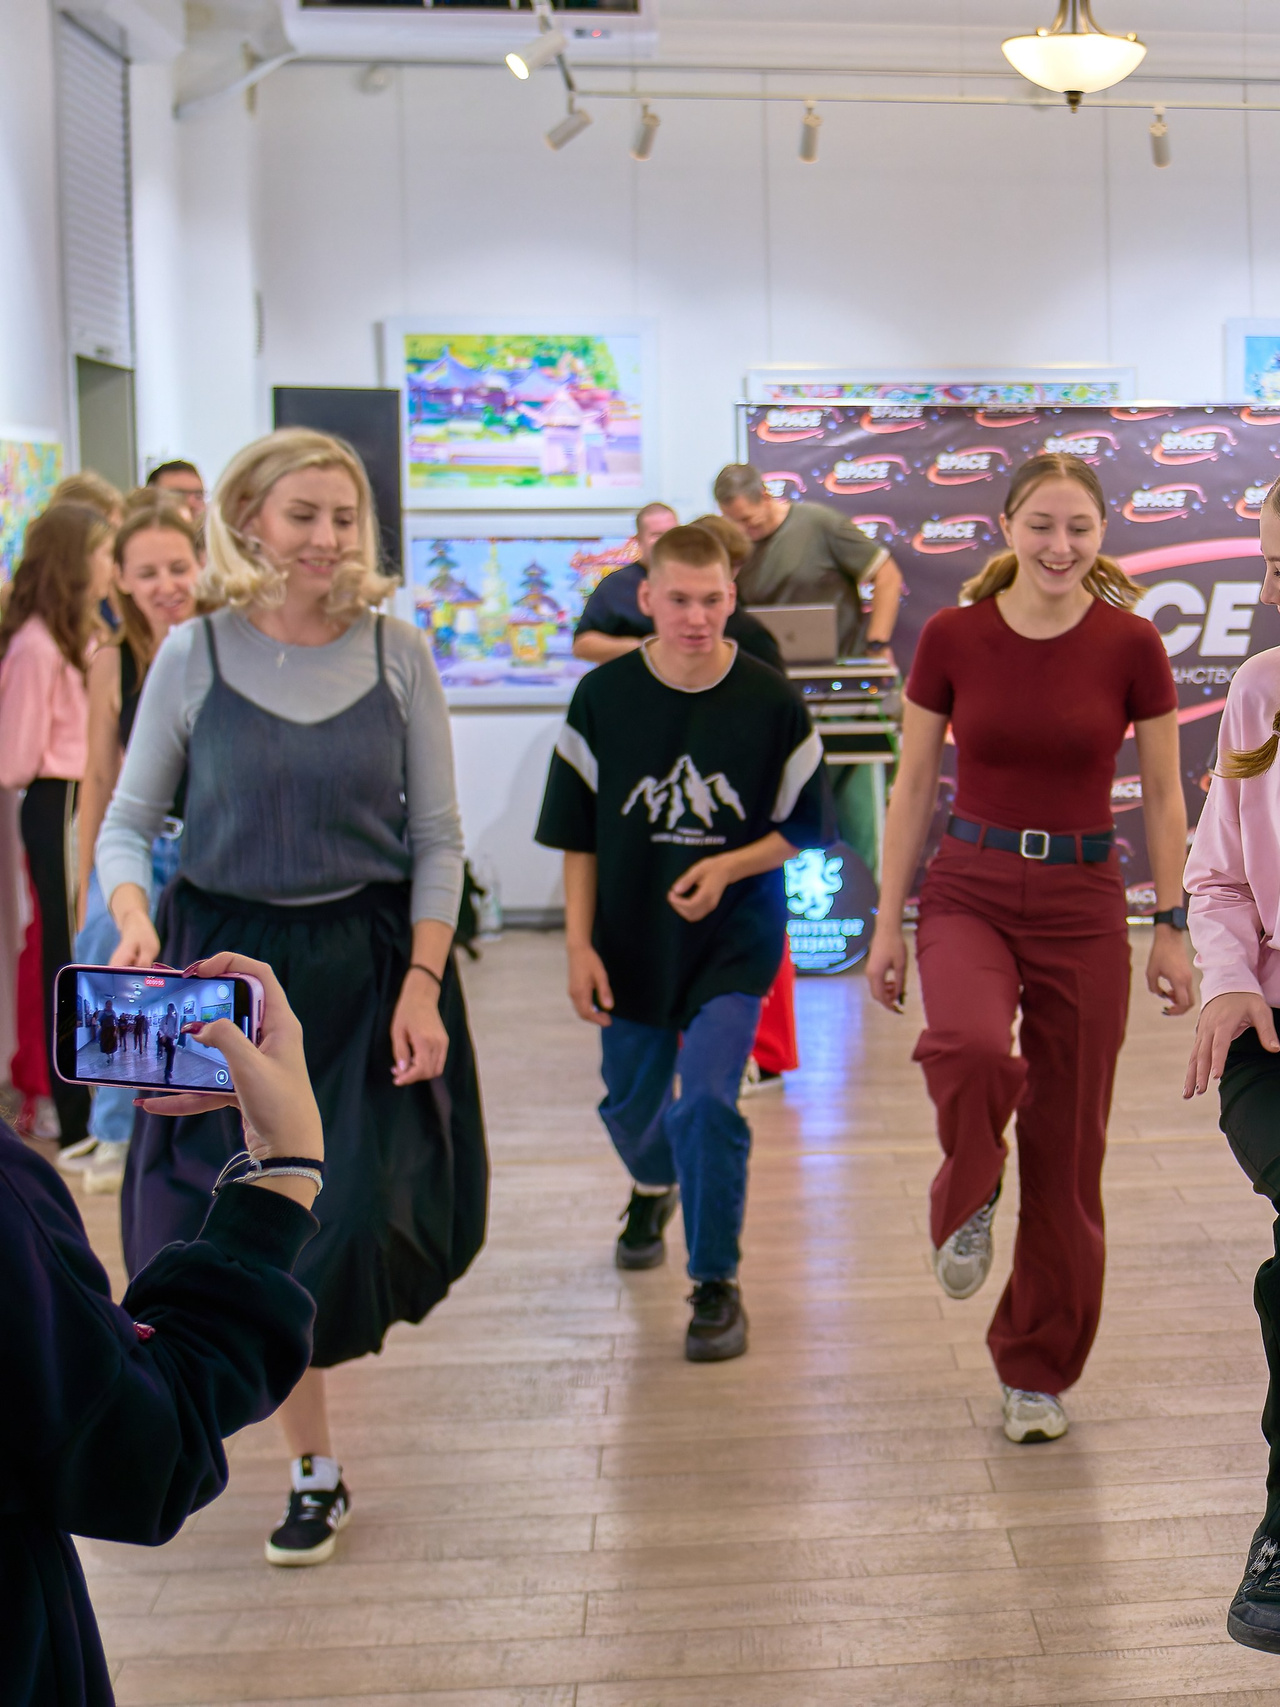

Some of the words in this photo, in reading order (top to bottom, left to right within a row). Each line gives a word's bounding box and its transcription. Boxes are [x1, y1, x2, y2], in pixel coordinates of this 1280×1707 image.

[766, 408, 823, 427] SPACE
[1161, 432, 1217, 450] SPACE
[834, 460, 890, 479] SPACE
[936, 452, 991, 470] SPACE
[1132, 490, 1187, 508] SPACE
[922, 521, 976, 539] SPACE
[1133, 580, 1262, 658] CE
